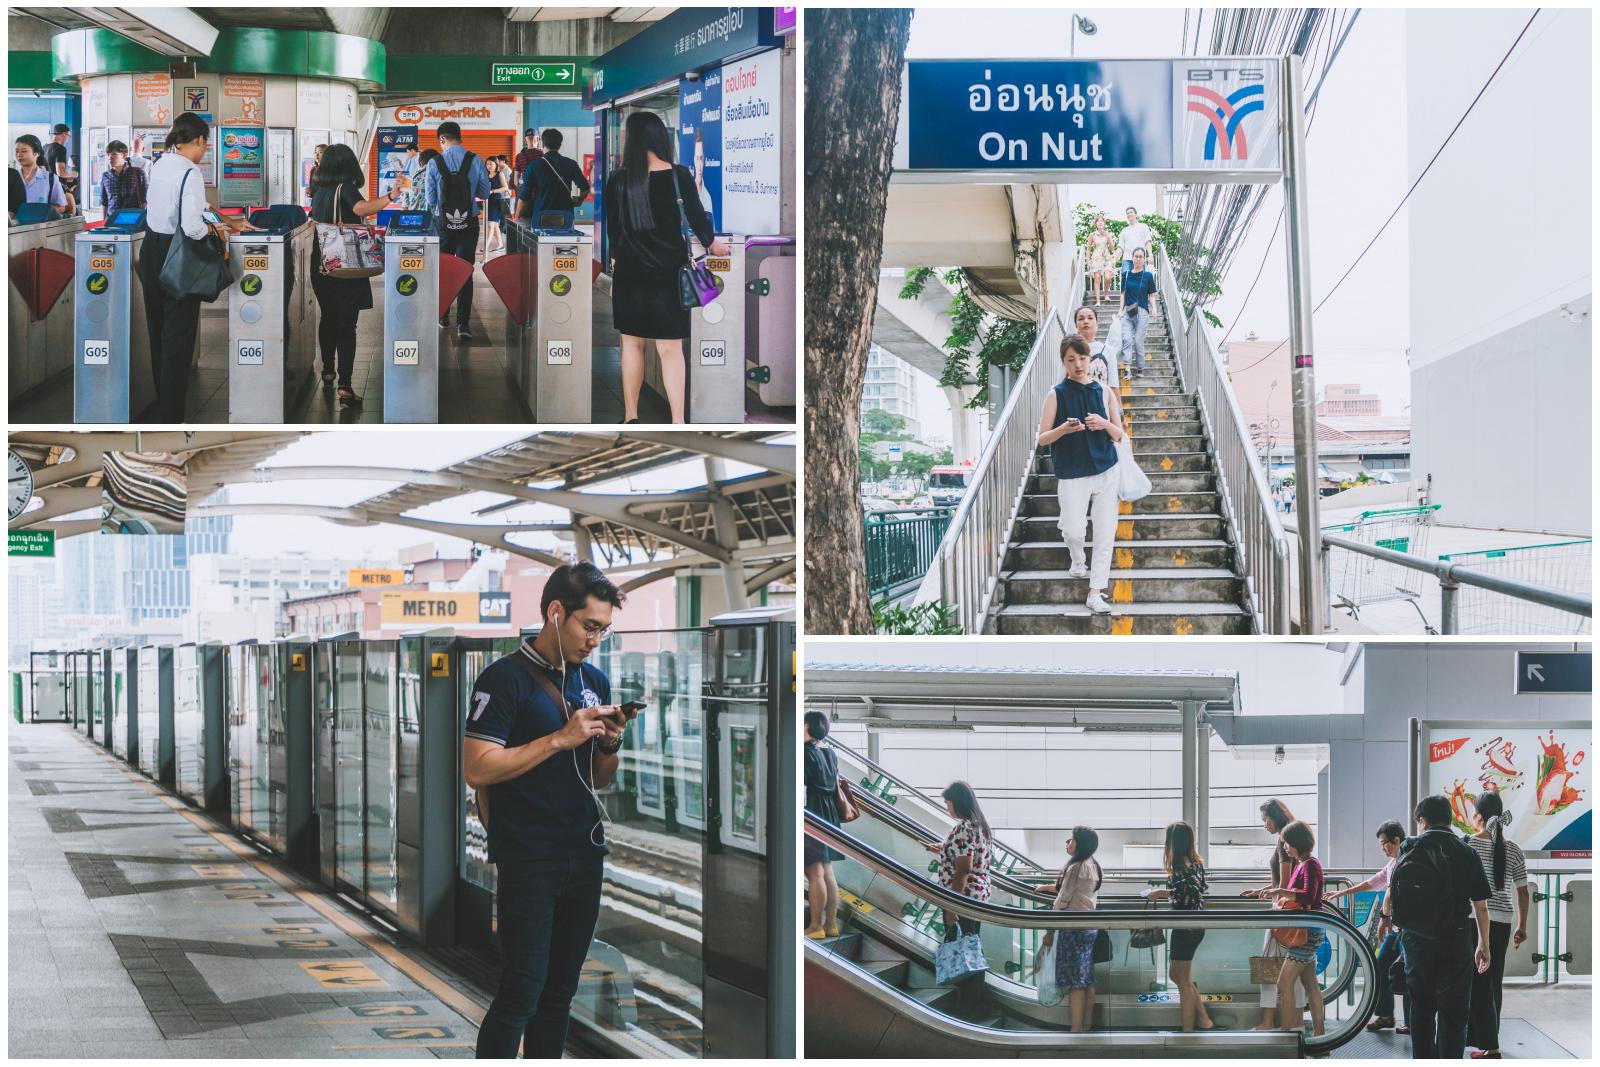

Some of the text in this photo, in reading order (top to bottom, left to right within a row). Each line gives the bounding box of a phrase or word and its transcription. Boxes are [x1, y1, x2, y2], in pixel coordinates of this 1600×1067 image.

[697, 7, 744, 42] ธนาคารยูโอบ
[496, 66, 530, 75] ทางออก
[1187, 68, 1265, 81] BTS
[592, 69, 604, 93] UOB
[725, 63, 758, 93] ตอบโจทย์
[967, 68, 1113, 129] อ่อนนุช
[424, 107, 491, 120] SuperRich
[978, 131, 1103, 161] On Nut
[92, 260, 112, 268] G05
[246, 259, 266, 268] G06
[402, 260, 422, 268] G07
[555, 260, 575, 269] G08
[709, 261, 728, 269] G09
[86, 347, 108, 357] G05
[239, 347, 262, 357] G06
[395, 348, 417, 358] G07
[549, 348, 570, 357] G08
[702, 348, 724, 358] G09
[362, 574, 391, 584] METRO
[403, 598, 511, 617] METRO CAT
[472, 691, 491, 721] 7
[1432, 742, 1455, 759] ใหม่!
